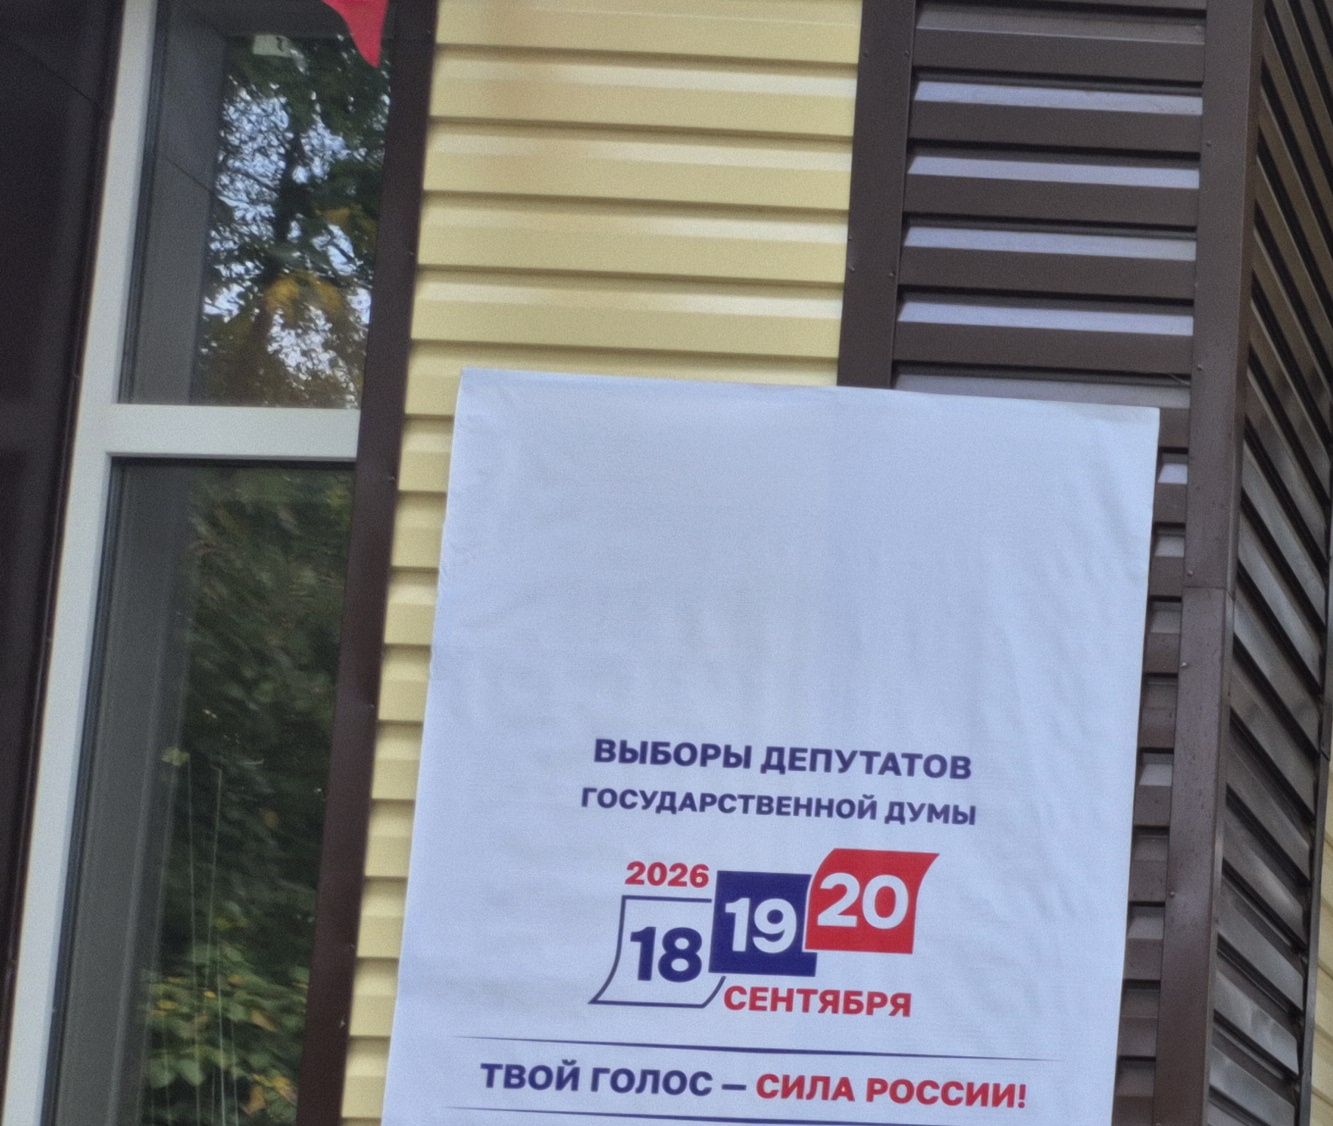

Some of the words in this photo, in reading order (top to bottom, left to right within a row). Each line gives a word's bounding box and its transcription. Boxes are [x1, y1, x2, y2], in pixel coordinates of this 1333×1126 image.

[594, 738, 752, 769] ВЫБОРЫ
[760, 746, 972, 780] ДЕПУТАТОВ
[581, 787, 878, 822] ГОСУДАРСТВЕННОЙ
[884, 800, 977, 826] ДУМЫ
[624, 860, 710, 888] 2026
[629, 925, 703, 983] 18
[723, 896, 798, 955] 19
[816, 871, 909, 930] 20
[722, 985, 913, 1018] СЕНТЯБРЯ
[480, 1059, 580, 1092] ТВОЙ
[590, 1066, 713, 1097] ГОЛОС
[756, 1073, 856, 1102] СИЛА
[866, 1077, 1028, 1109] РОССИИ!
